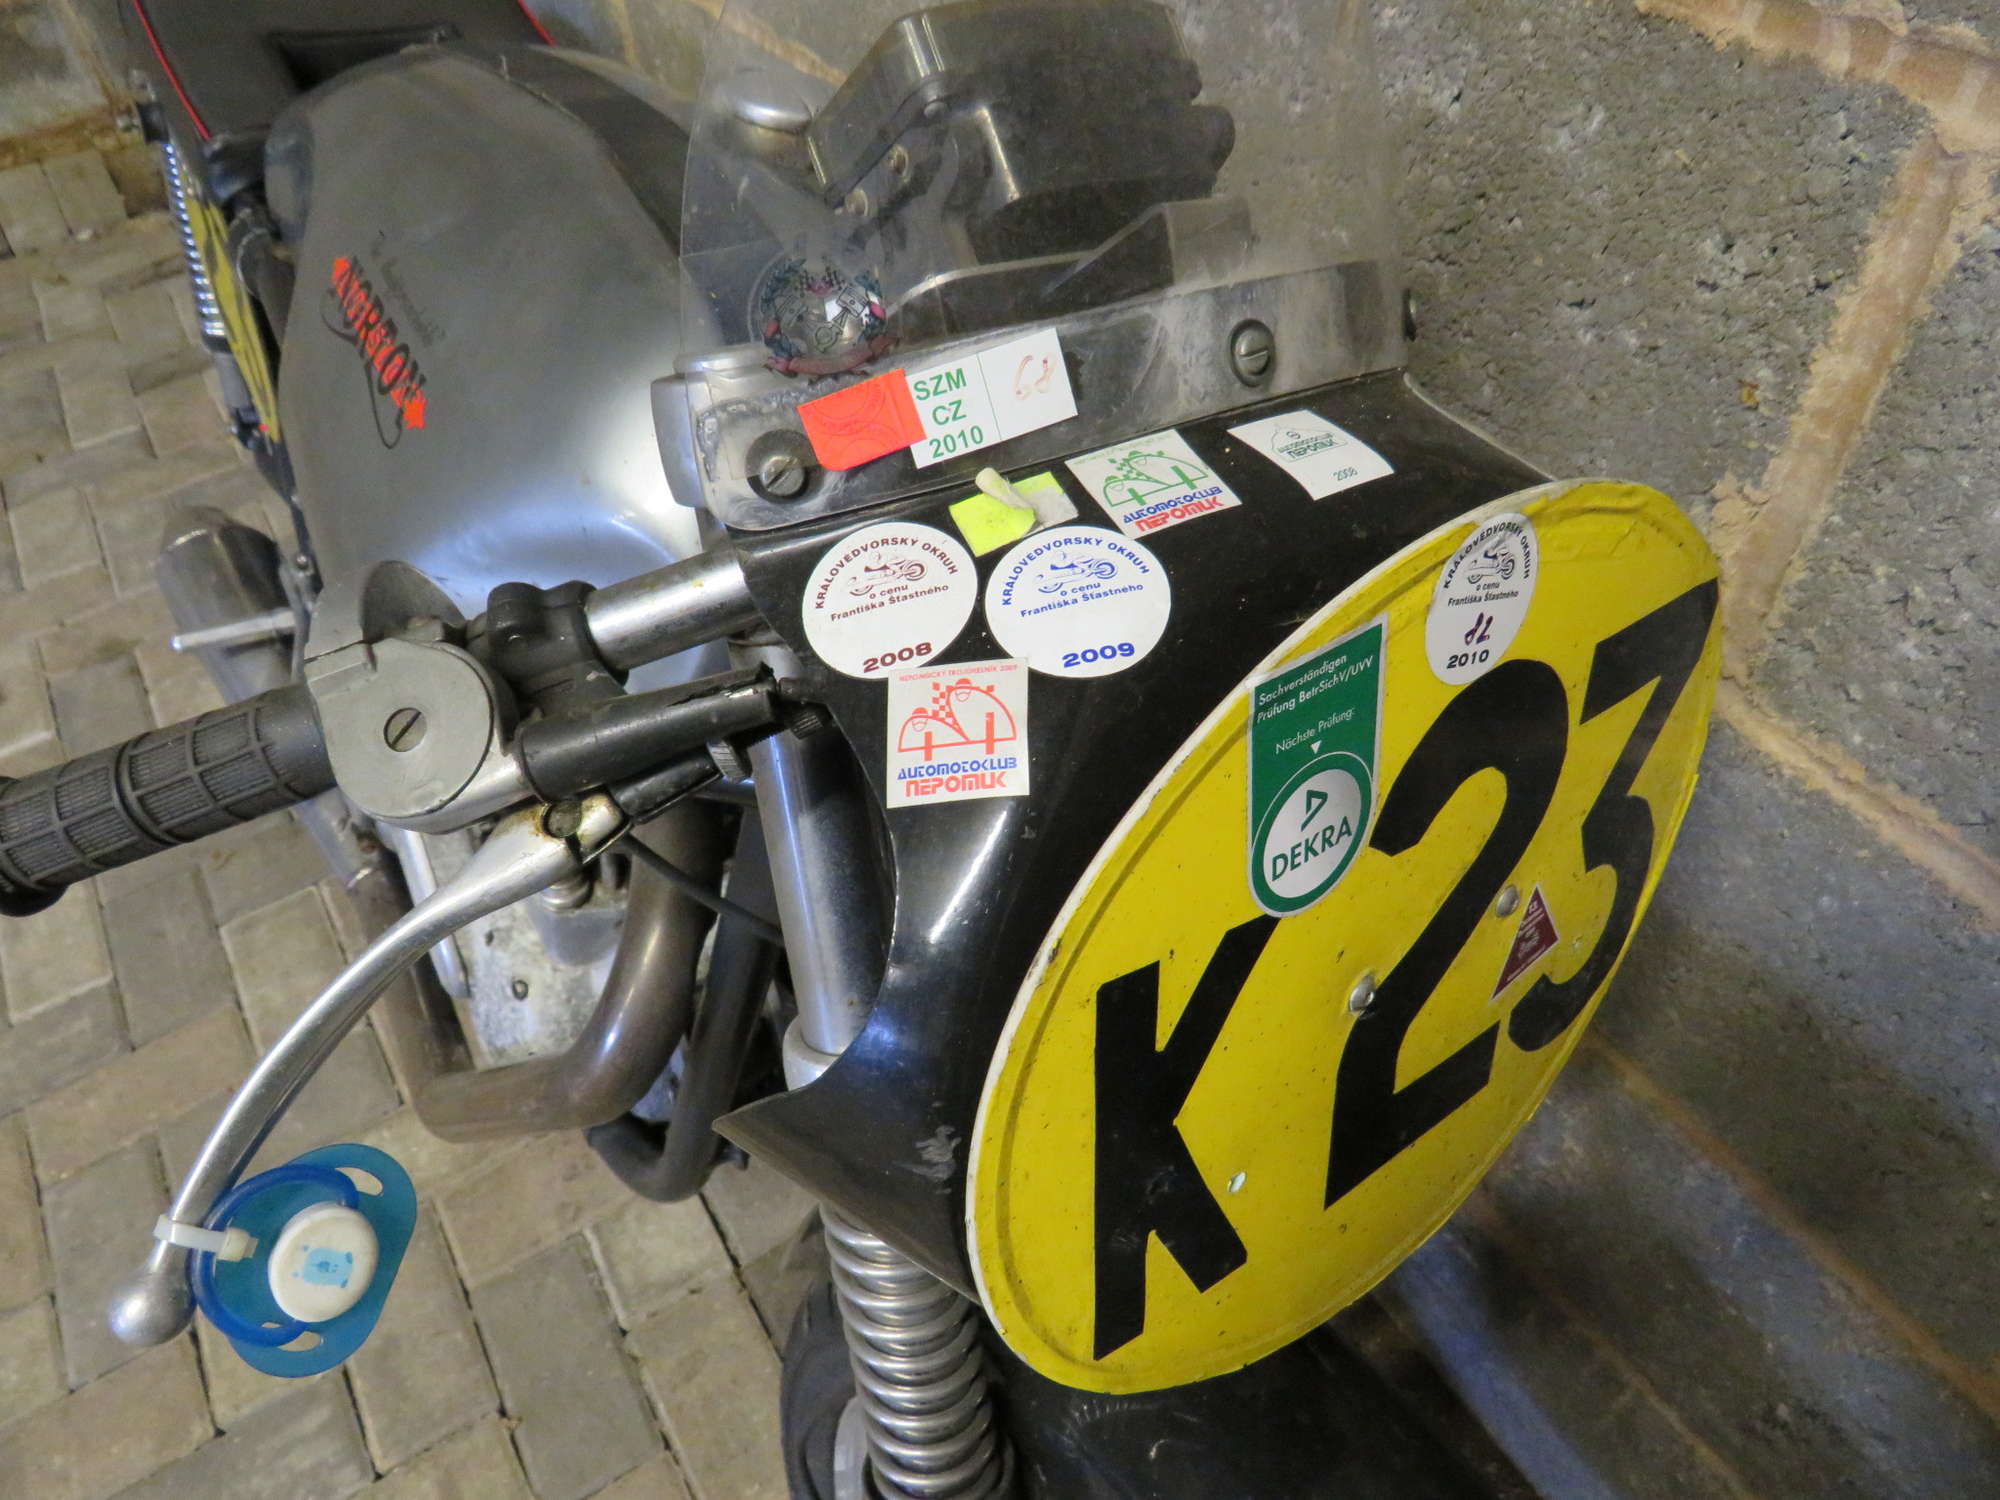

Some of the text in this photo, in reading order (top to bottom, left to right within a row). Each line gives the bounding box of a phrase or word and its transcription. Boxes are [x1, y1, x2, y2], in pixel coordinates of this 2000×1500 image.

[913, 367, 967, 401] SZM
[931, 400, 967, 427] CZ
[928, 425, 984, 459] 2010
[921, 542, 959, 575] OKRUH
[1107, 541, 1150, 575] OKRUH
[879, 584, 909, 597] cenu
[1071, 582, 1102, 594] cenu
[863, 641, 933, 673] 2008
[1062, 642, 1136, 668] 2009
[1446, 649, 1490, 670] 2010
[1258, 654, 1348, 706] Sachverständigen
[1256, 698, 1297, 724] Prüfung
[1275, 728, 1316, 755] Nächste
[905, 771, 1008, 797] NEPOMUK
[1271, 815, 1353, 882] DEKRA
